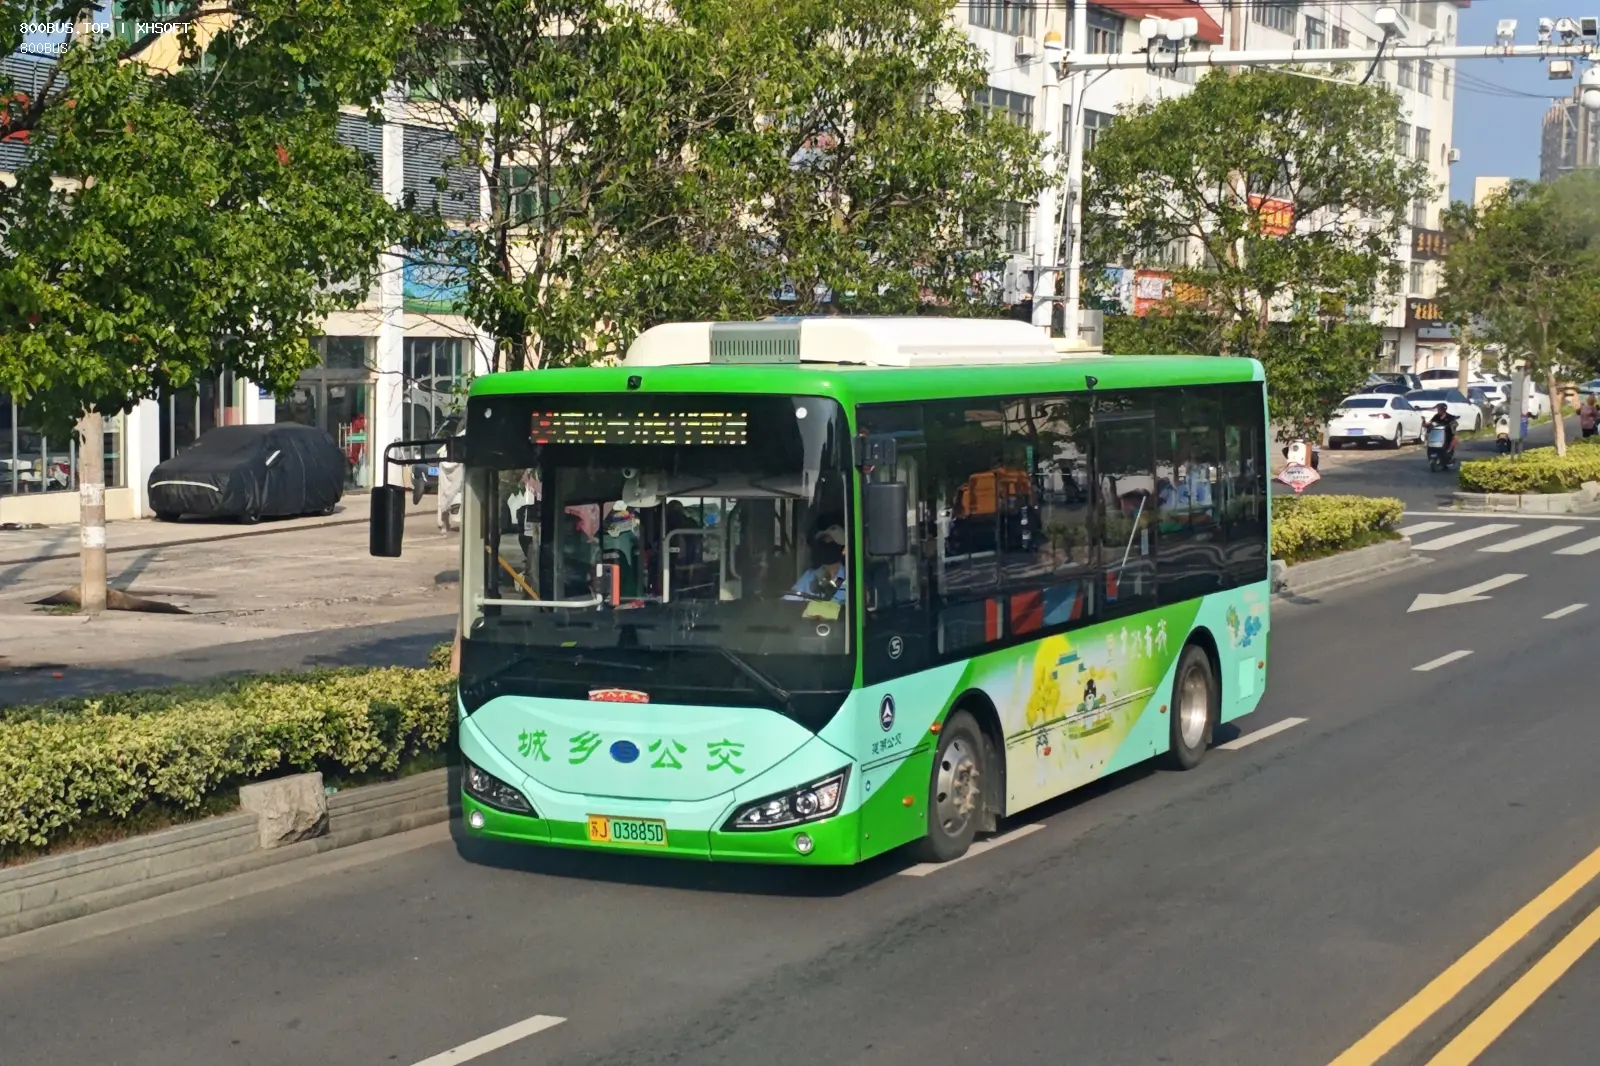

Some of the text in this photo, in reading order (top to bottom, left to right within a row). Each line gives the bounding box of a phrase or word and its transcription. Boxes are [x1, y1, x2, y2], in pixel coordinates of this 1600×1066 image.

[517, 728, 746, 775] 城乡公交
[613, 821, 664, 842] 03885D
